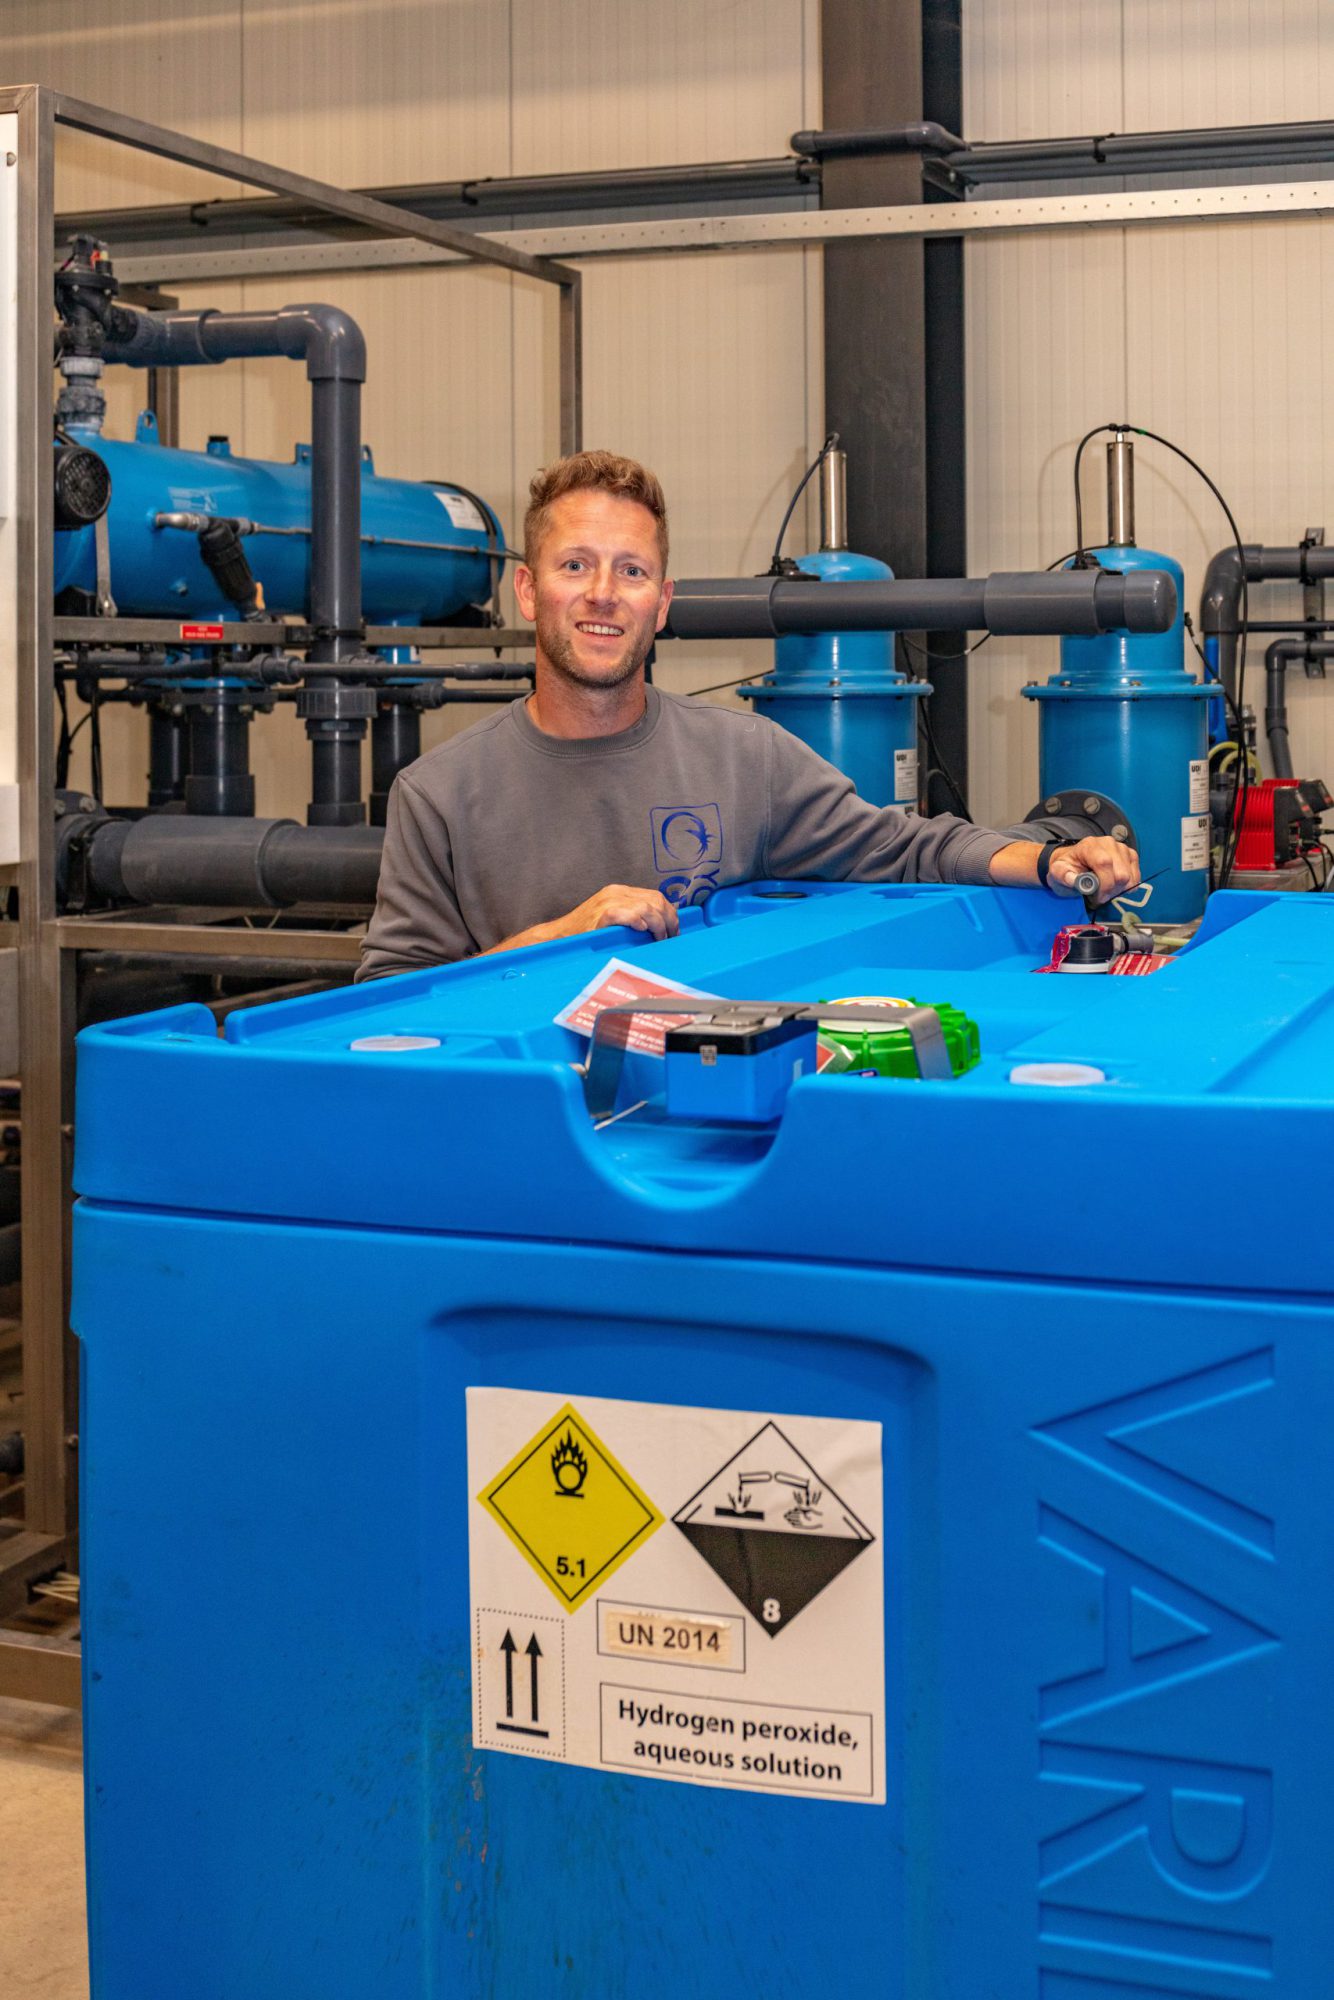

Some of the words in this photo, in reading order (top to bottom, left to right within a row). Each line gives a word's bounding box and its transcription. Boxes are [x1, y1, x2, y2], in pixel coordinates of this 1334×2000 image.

[555, 1555, 586, 1579] 5.1
[762, 1598, 781, 1623] 8
[619, 1623, 655, 1646] UN
[663, 1626, 720, 1652] 2014
[1029, 1344, 1284, 2000] VARI
[618, 1699, 735, 1737] Hydrogen
[742, 1720, 859, 1750] peroxide,
[633, 1740, 735, 1768] aqueous
[741, 1751, 842, 1781] solution
